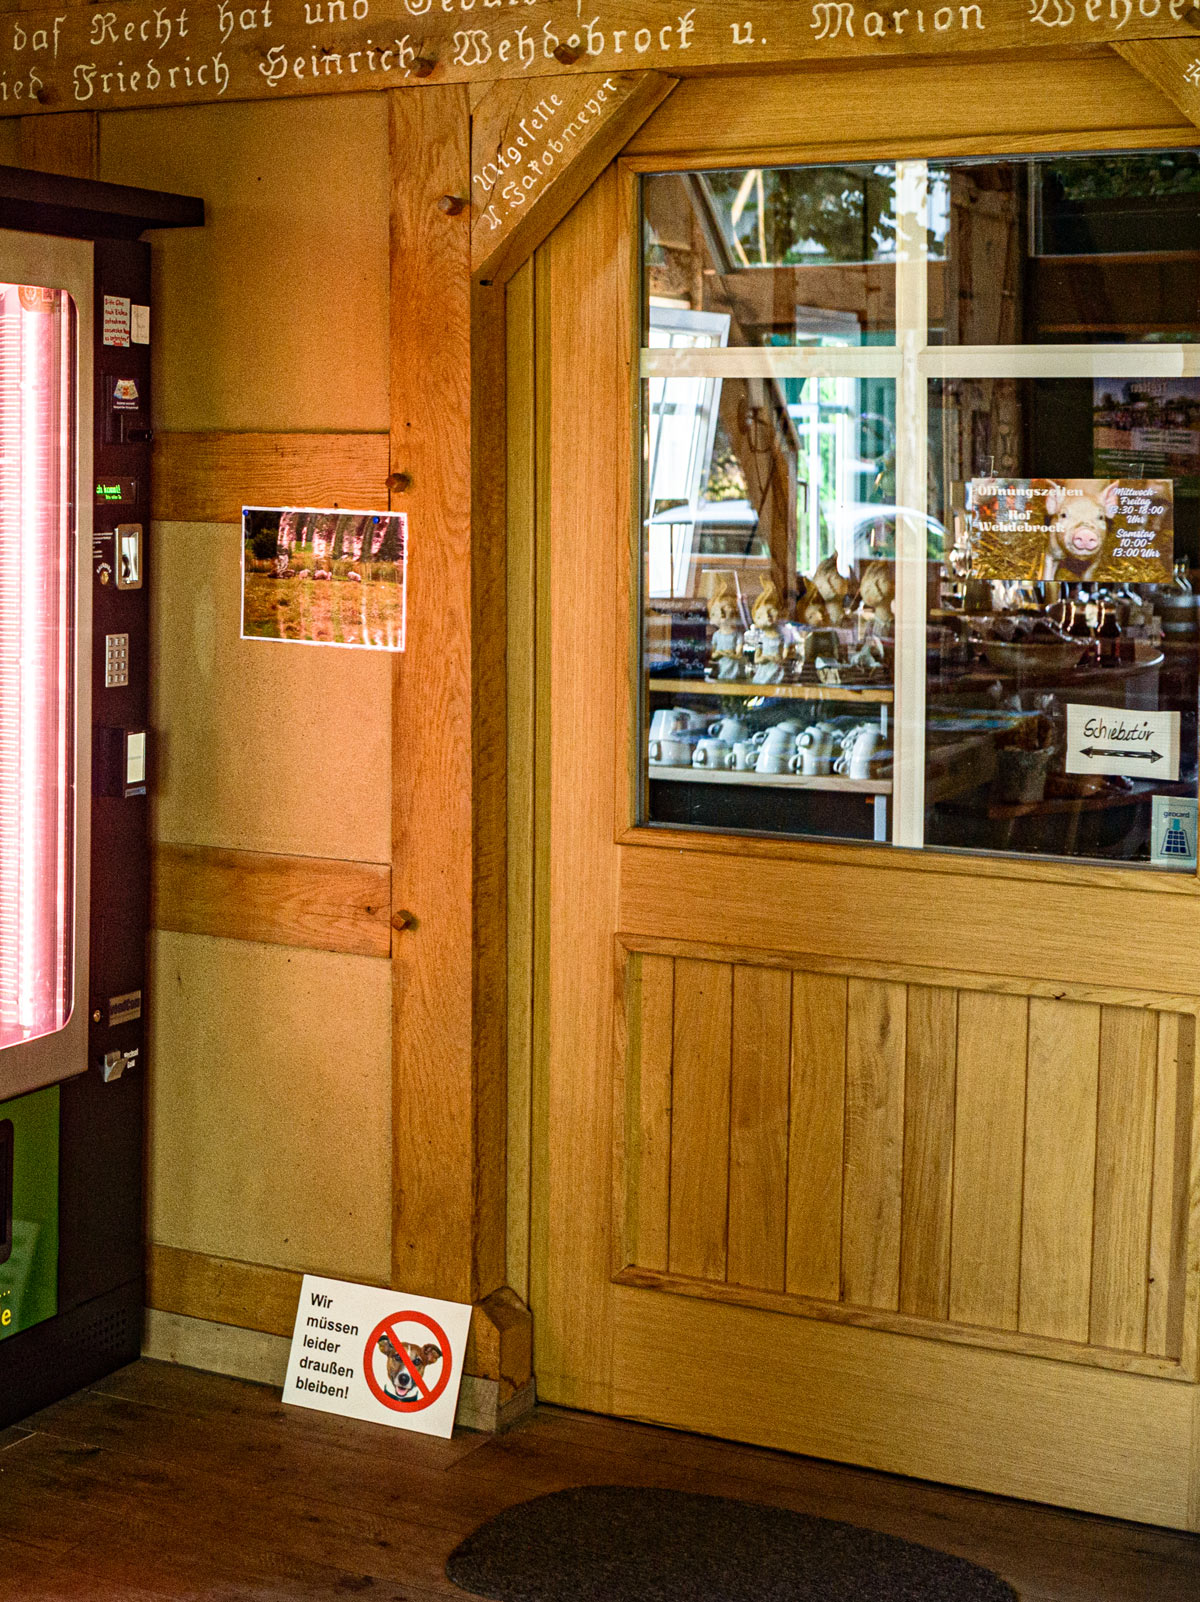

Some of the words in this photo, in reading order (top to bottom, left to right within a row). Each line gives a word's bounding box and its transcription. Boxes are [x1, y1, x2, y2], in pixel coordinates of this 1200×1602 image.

[89, 7, 189, 50] Recht
[217, 0, 273, 44] hat
[72, 52, 230, 101] Friedrich
[258, 34, 416, 88] Heinrich
[729, 21, 768, 46] u.
[809, 2, 986, 41] Marion
[1120, 496, 1152, 508] Freitag
[1008, 510, 1033, 521] Hof
[1126, 515, 1146, 524] Uhr
[978, 522, 1065, 533] Wehdebrock
[1116, 528, 1156, 540] Samstag
[1112, 548, 1139, 557] 13:00
[1140, 548, 1160, 558] Uhr
[310, 1293, 334, 1309] Wir
[306, 1316, 359, 1336] müssen
[303, 1334, 341, 1353] leider
[299, 1356, 354, 1379] draußen
[295, 1376, 350, 1399] bleiben!
